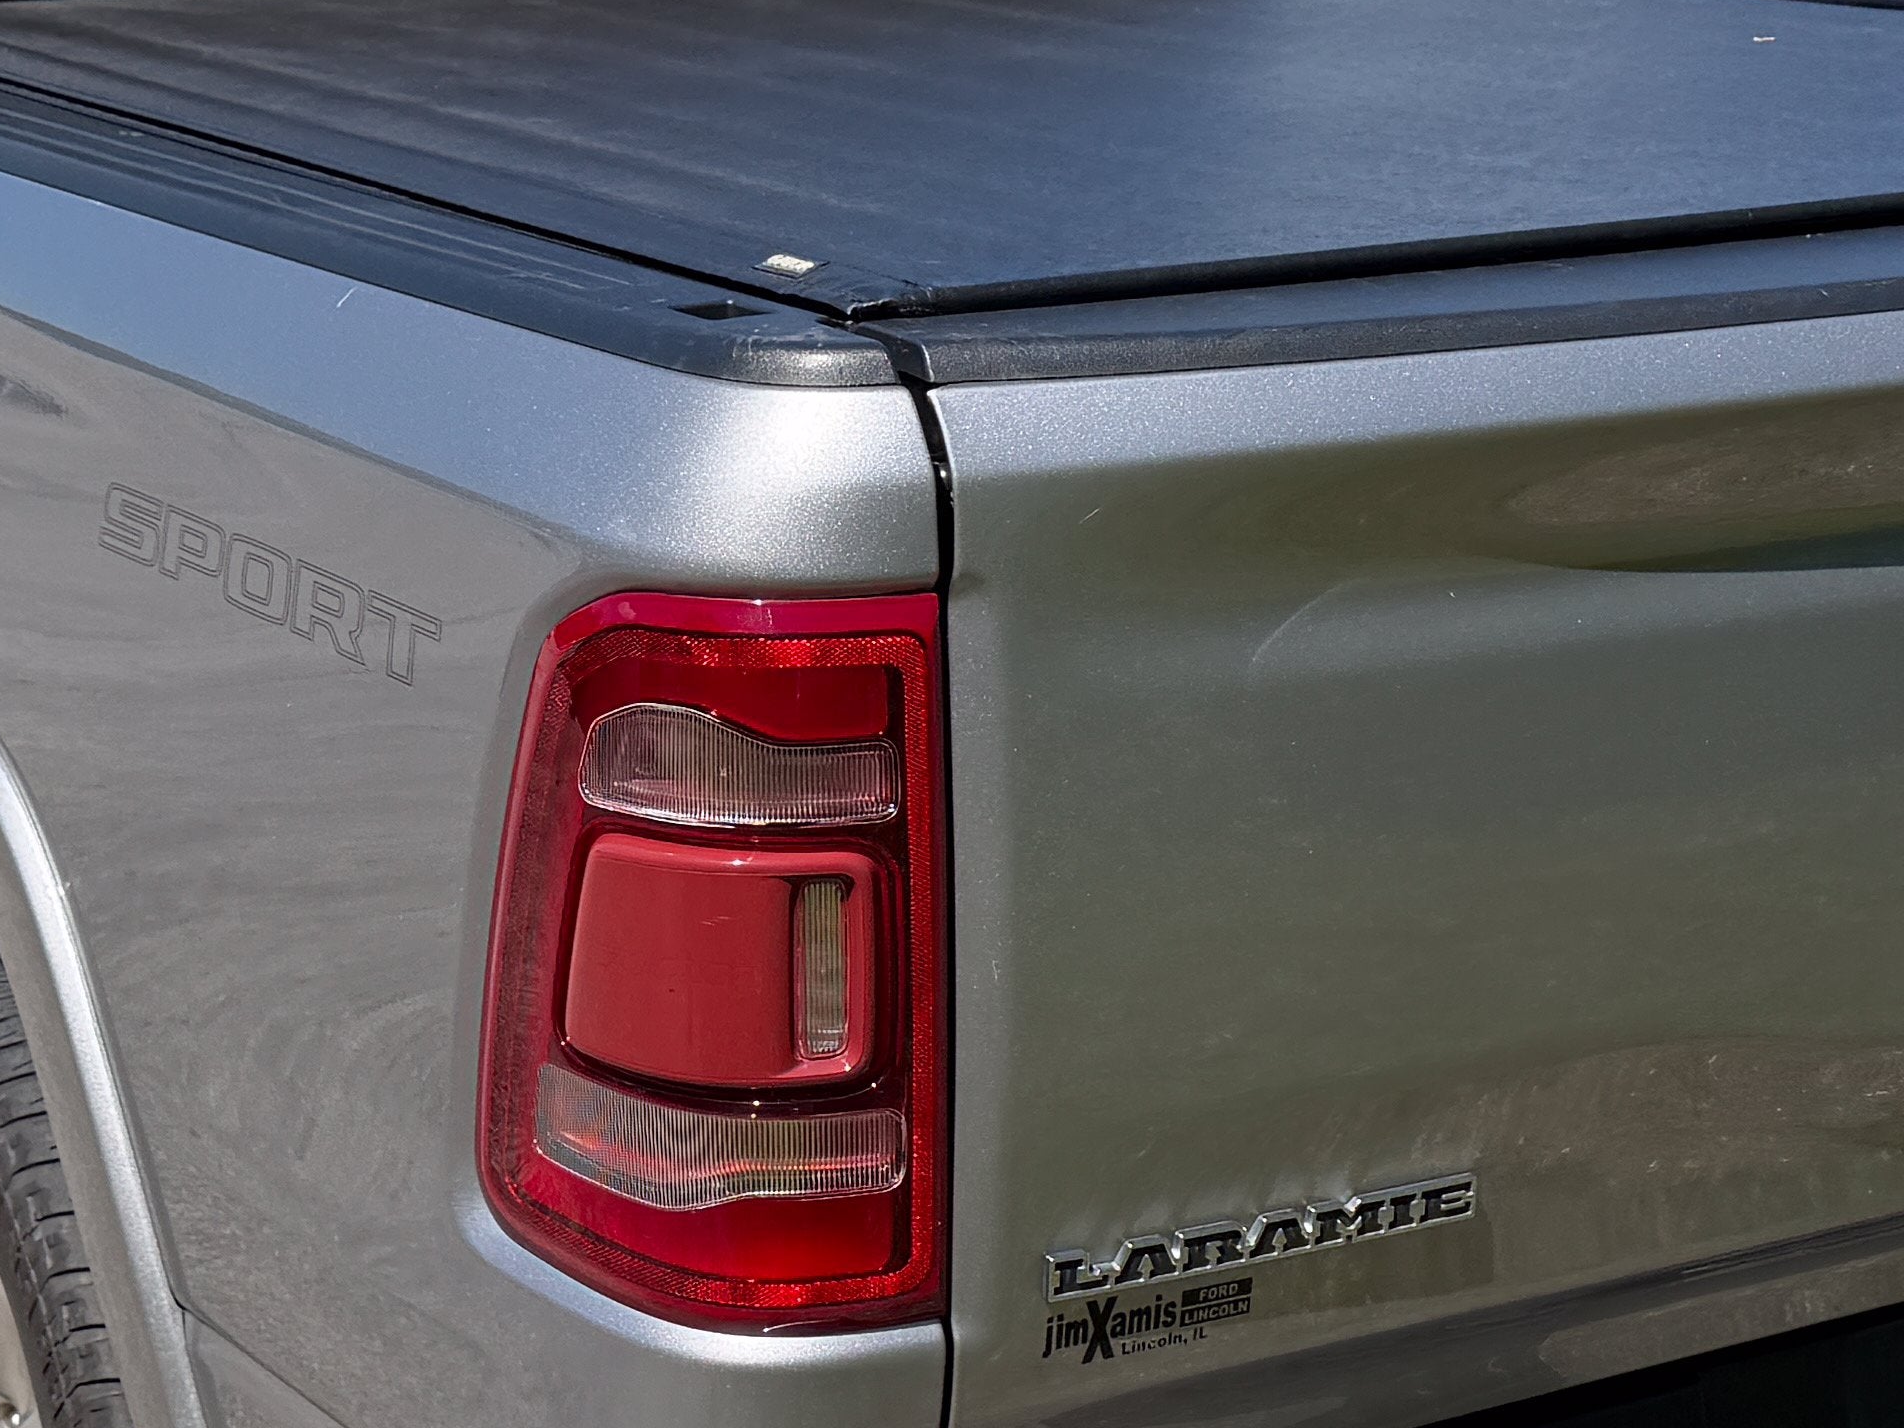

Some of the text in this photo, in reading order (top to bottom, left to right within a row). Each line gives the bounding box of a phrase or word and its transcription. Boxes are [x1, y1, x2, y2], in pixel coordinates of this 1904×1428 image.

[99, 482, 443, 686] SPORT
[1044, 1172, 1477, 1303] LARAMIE
[1183, 1300, 1249, 1324] LINCOLN
[1198, 1283, 1239, 1302] FORD
